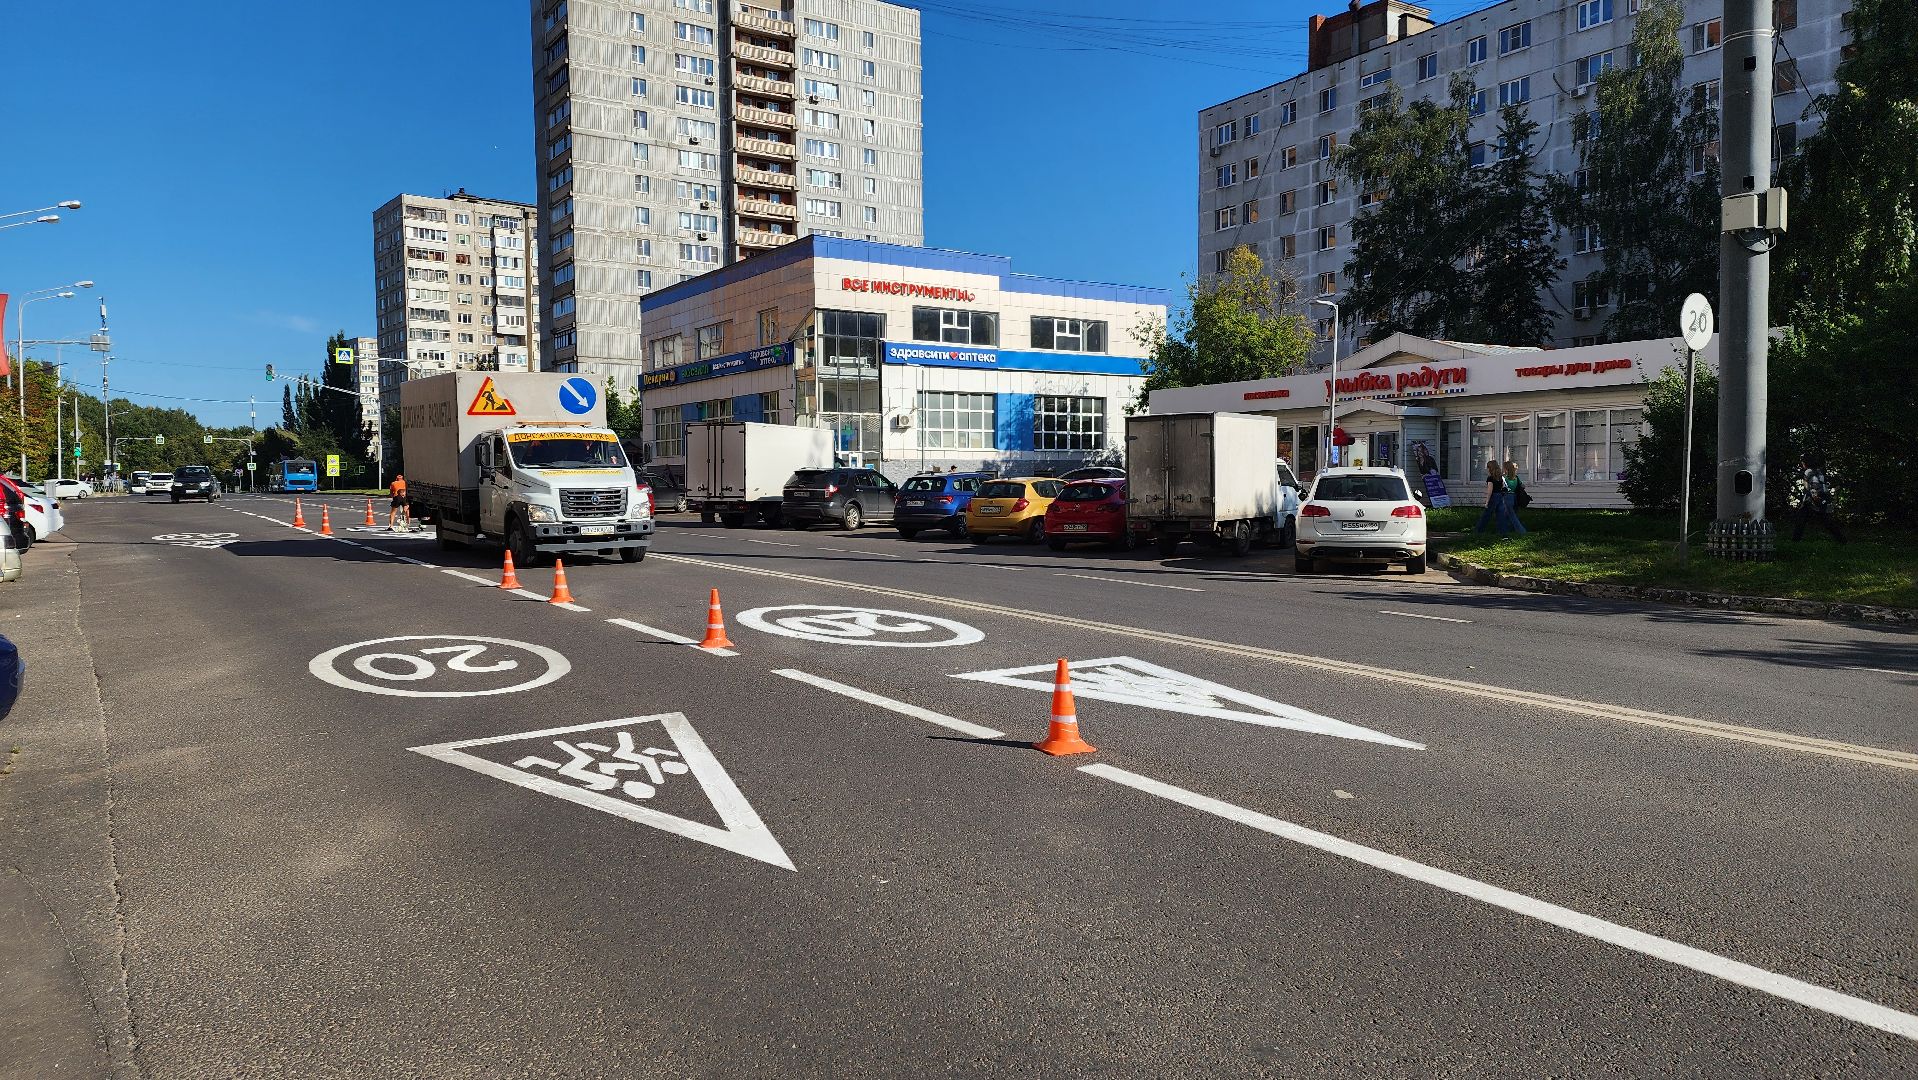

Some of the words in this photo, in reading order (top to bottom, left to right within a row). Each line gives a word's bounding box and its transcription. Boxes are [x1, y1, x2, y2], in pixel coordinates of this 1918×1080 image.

[841, 277, 869, 292] ВСЕ
[871, 281, 968, 302] ИНСТРУМЕНТЫ
[1689, 309, 1706, 333] 20
[890, 347, 949, 361] здравсити
[959, 352, 996, 363] аптека
[1396, 365, 1467, 392] радуги
[353, 644, 519, 681] 20
